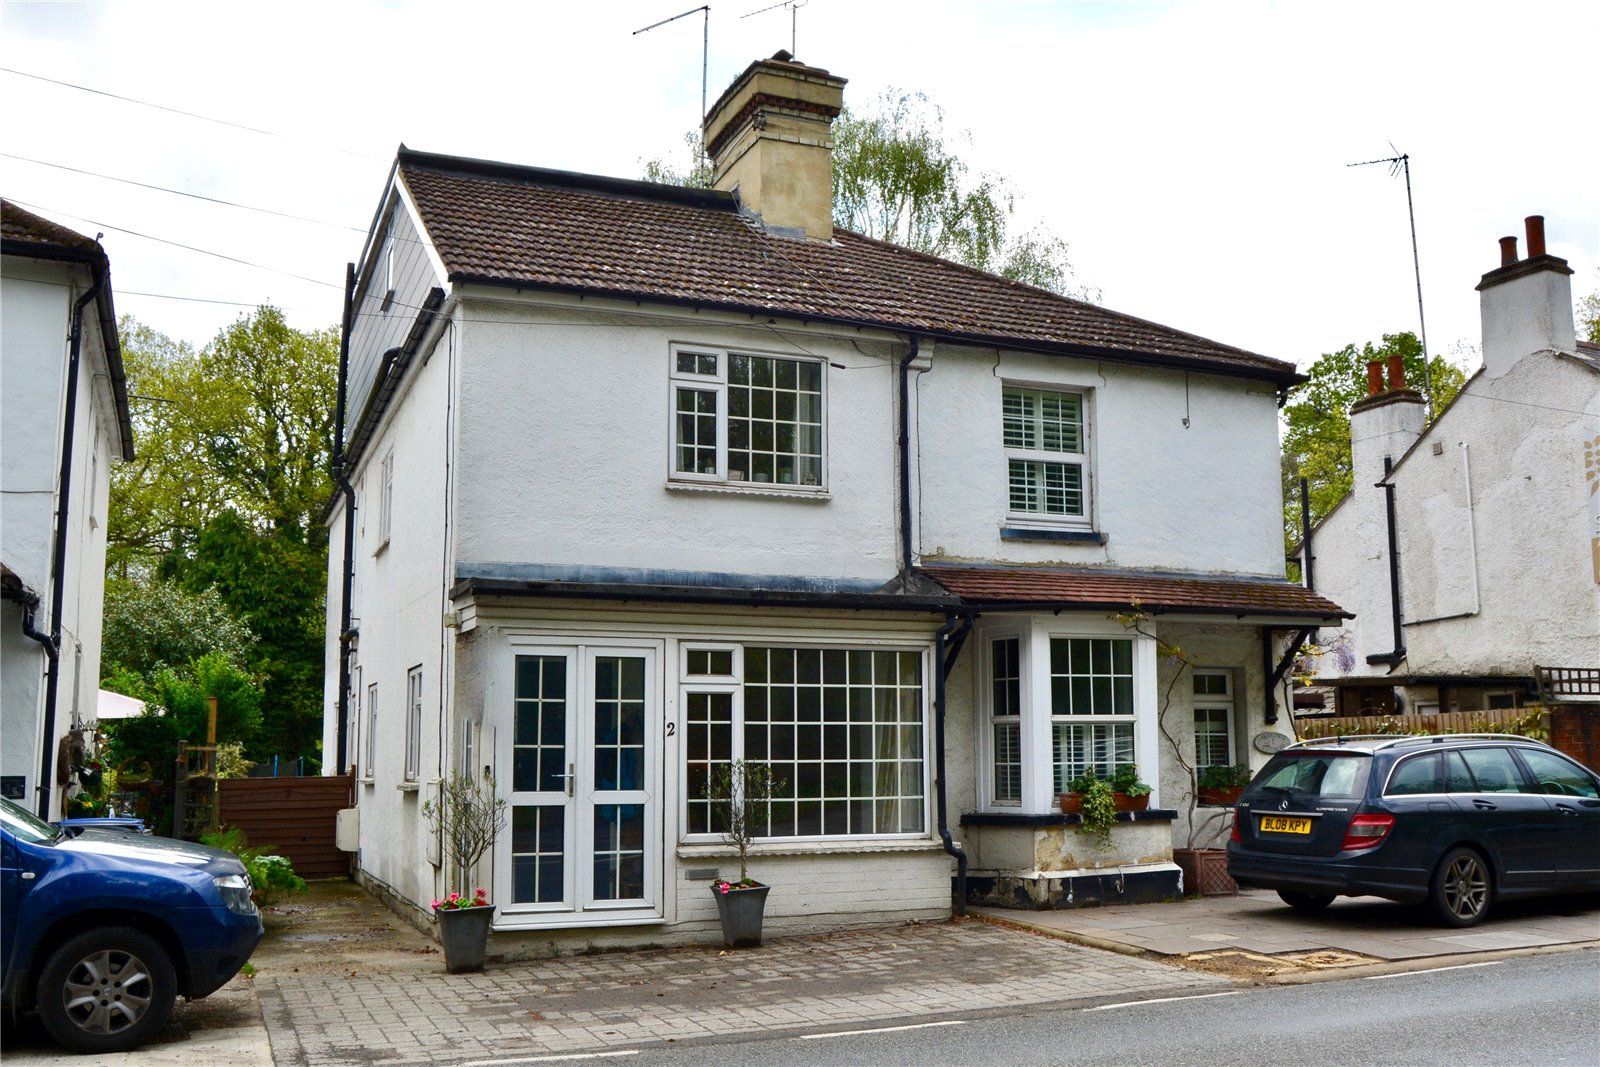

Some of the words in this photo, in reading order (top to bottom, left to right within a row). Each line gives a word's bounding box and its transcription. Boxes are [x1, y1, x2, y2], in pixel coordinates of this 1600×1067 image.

[667, 722, 675, 737] 2
[1264, 818, 1287, 830] BL08
[1289, 820, 1307, 831] KPY
